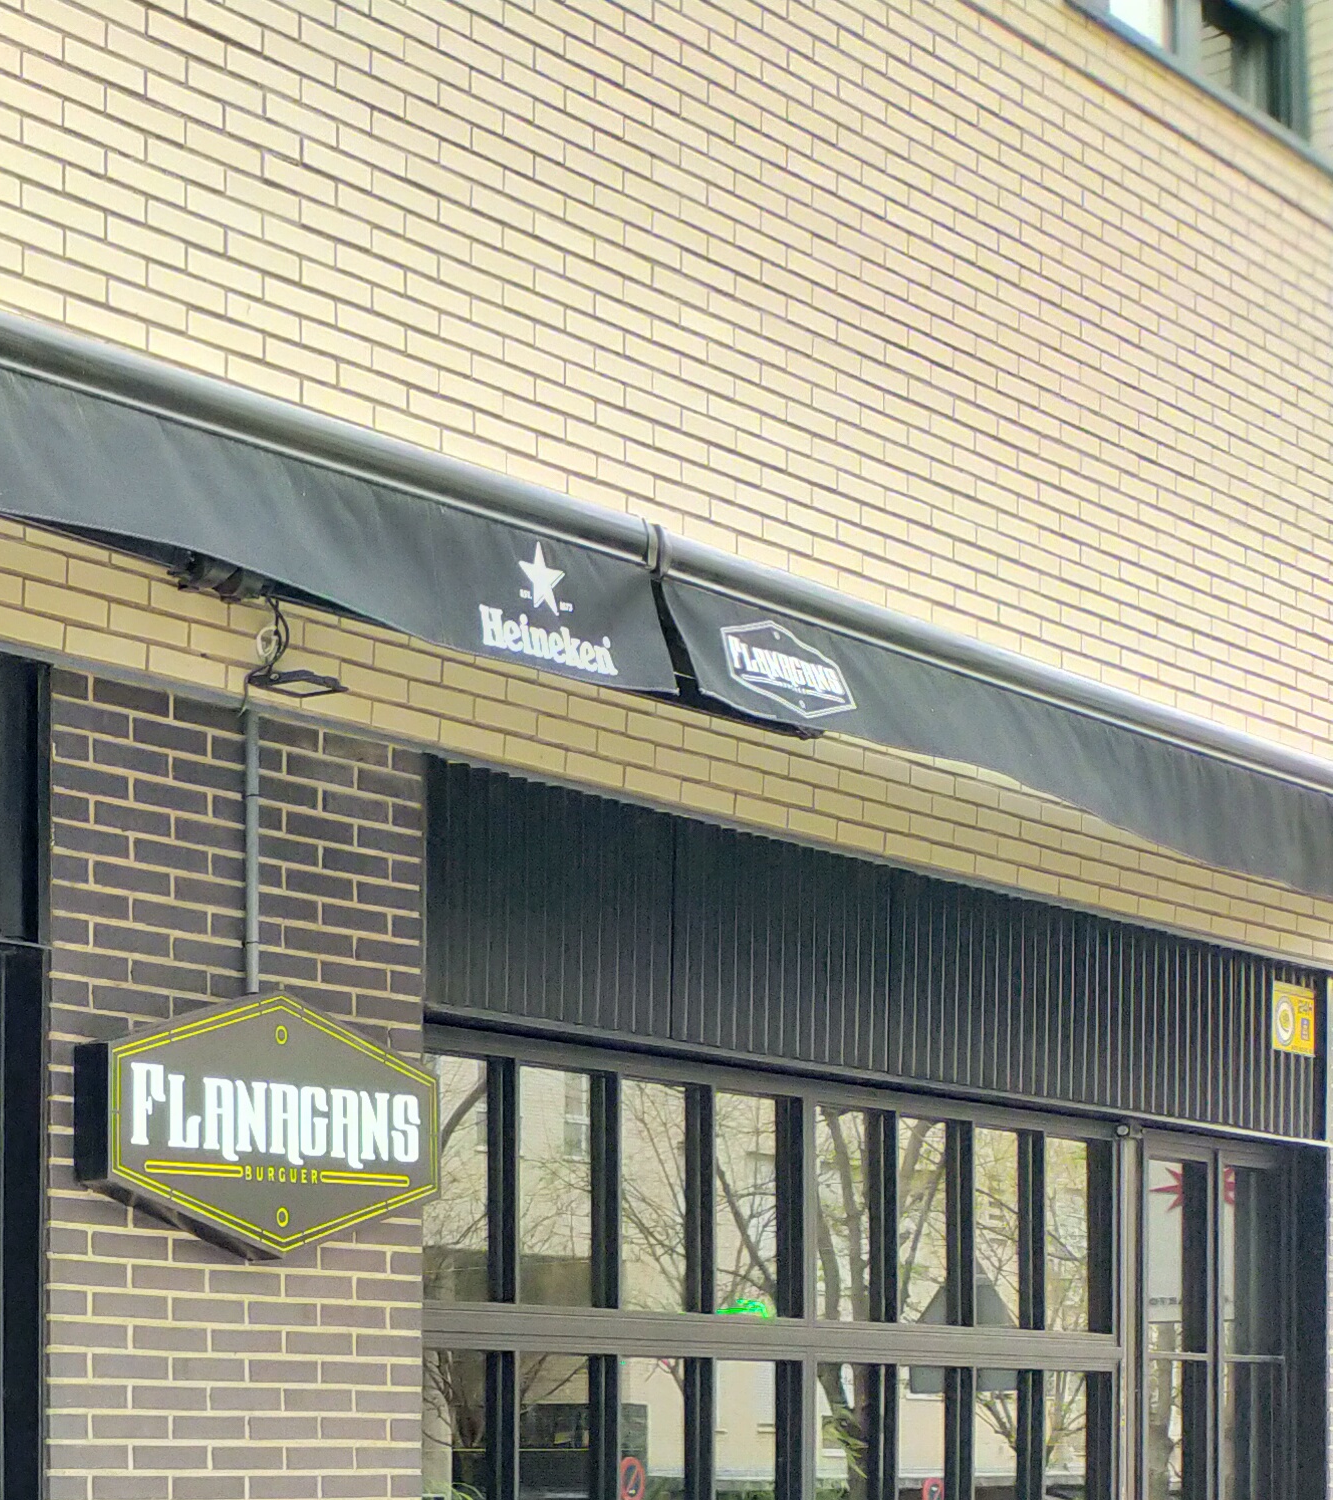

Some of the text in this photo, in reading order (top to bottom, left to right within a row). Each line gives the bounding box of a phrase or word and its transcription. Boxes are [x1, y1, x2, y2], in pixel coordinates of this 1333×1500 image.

[479, 604, 618, 676] Heineken
[130, 1062, 421, 1169] FLANAGANS
[244, 1165, 319, 1185] BURGUER
